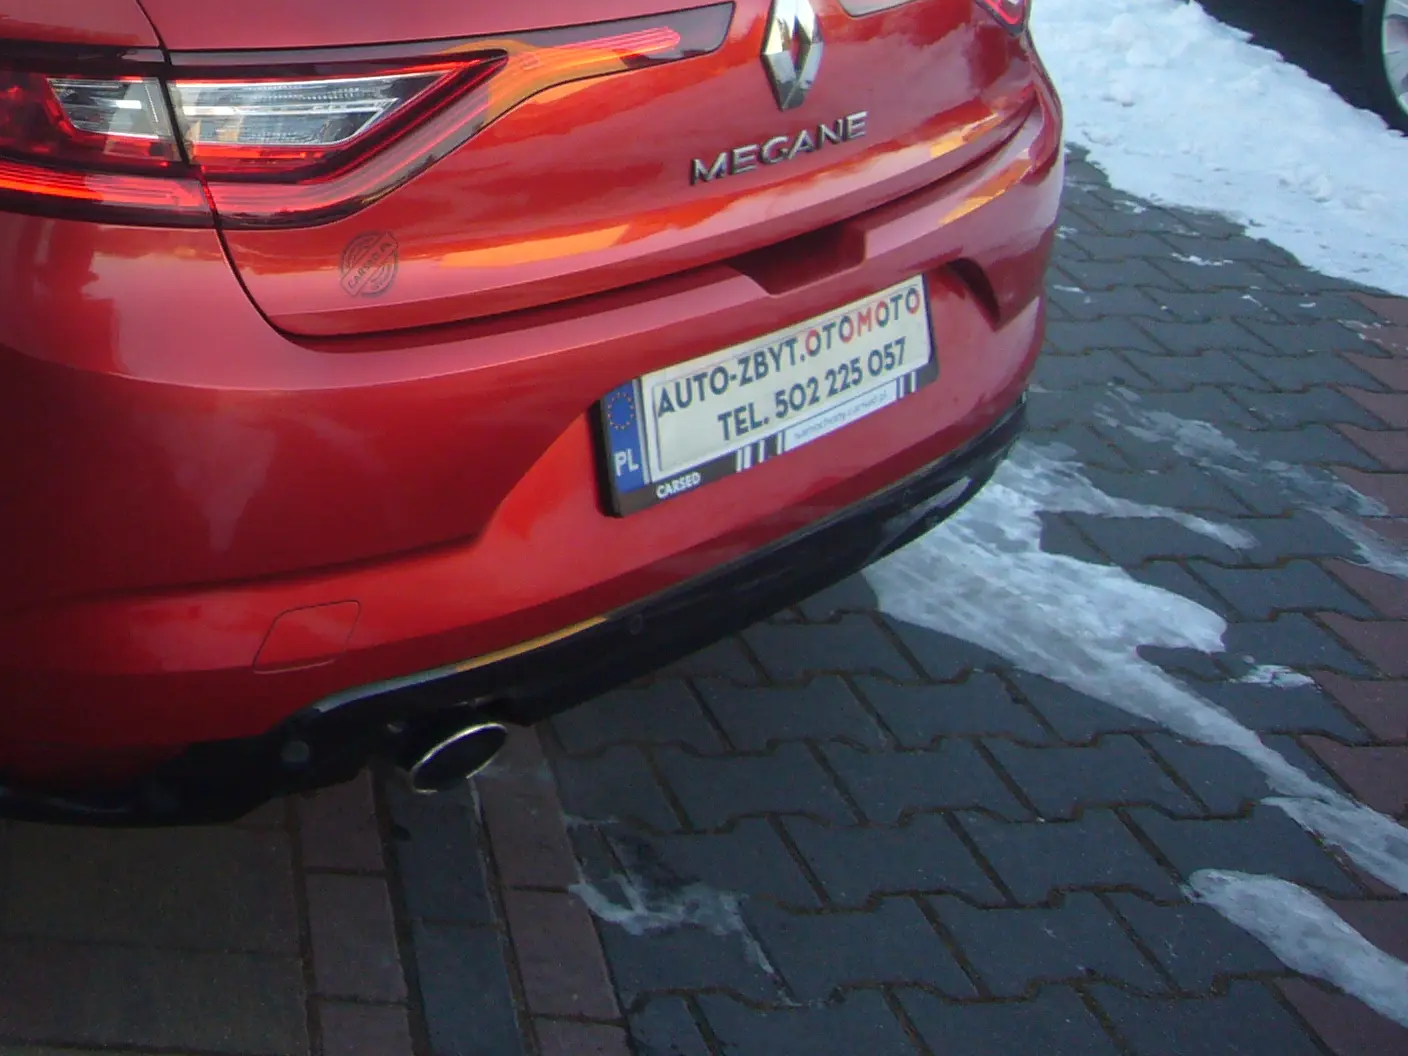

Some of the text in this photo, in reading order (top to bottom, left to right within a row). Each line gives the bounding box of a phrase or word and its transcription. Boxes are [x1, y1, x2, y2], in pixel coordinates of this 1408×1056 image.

[690, 111, 869, 186] MEGANE
[657, 287, 921, 418] AUTO-ZBYT.OTOMOTO
[717, 337, 906, 441] TEL. 502 225 057
[614, 448, 640, 477] PL
[656, 471, 702, 500] CARSED
